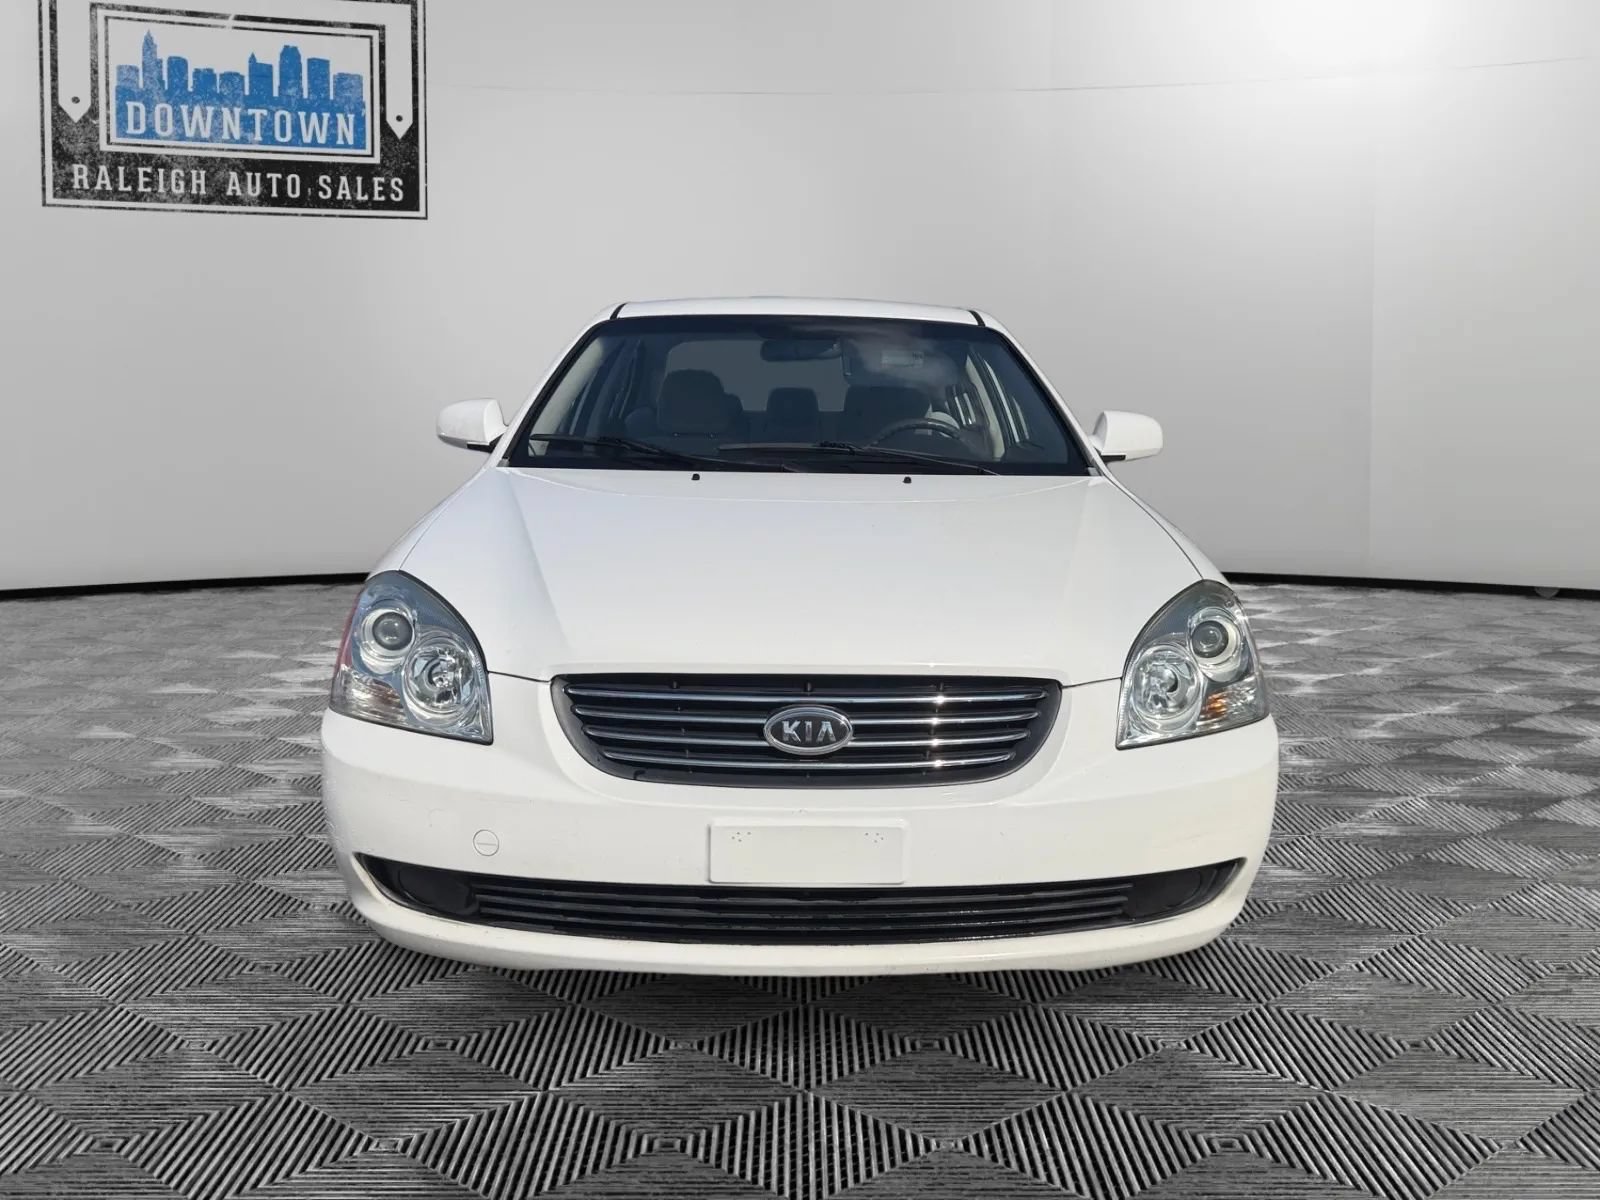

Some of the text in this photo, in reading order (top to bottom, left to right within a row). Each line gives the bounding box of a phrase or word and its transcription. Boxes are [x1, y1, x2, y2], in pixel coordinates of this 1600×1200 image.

[125, 100, 355, 146] DOWNTOWN
[72, 163, 404, 202] RALEIGH AUTO SALES
[781, 720, 837, 742] KIA
